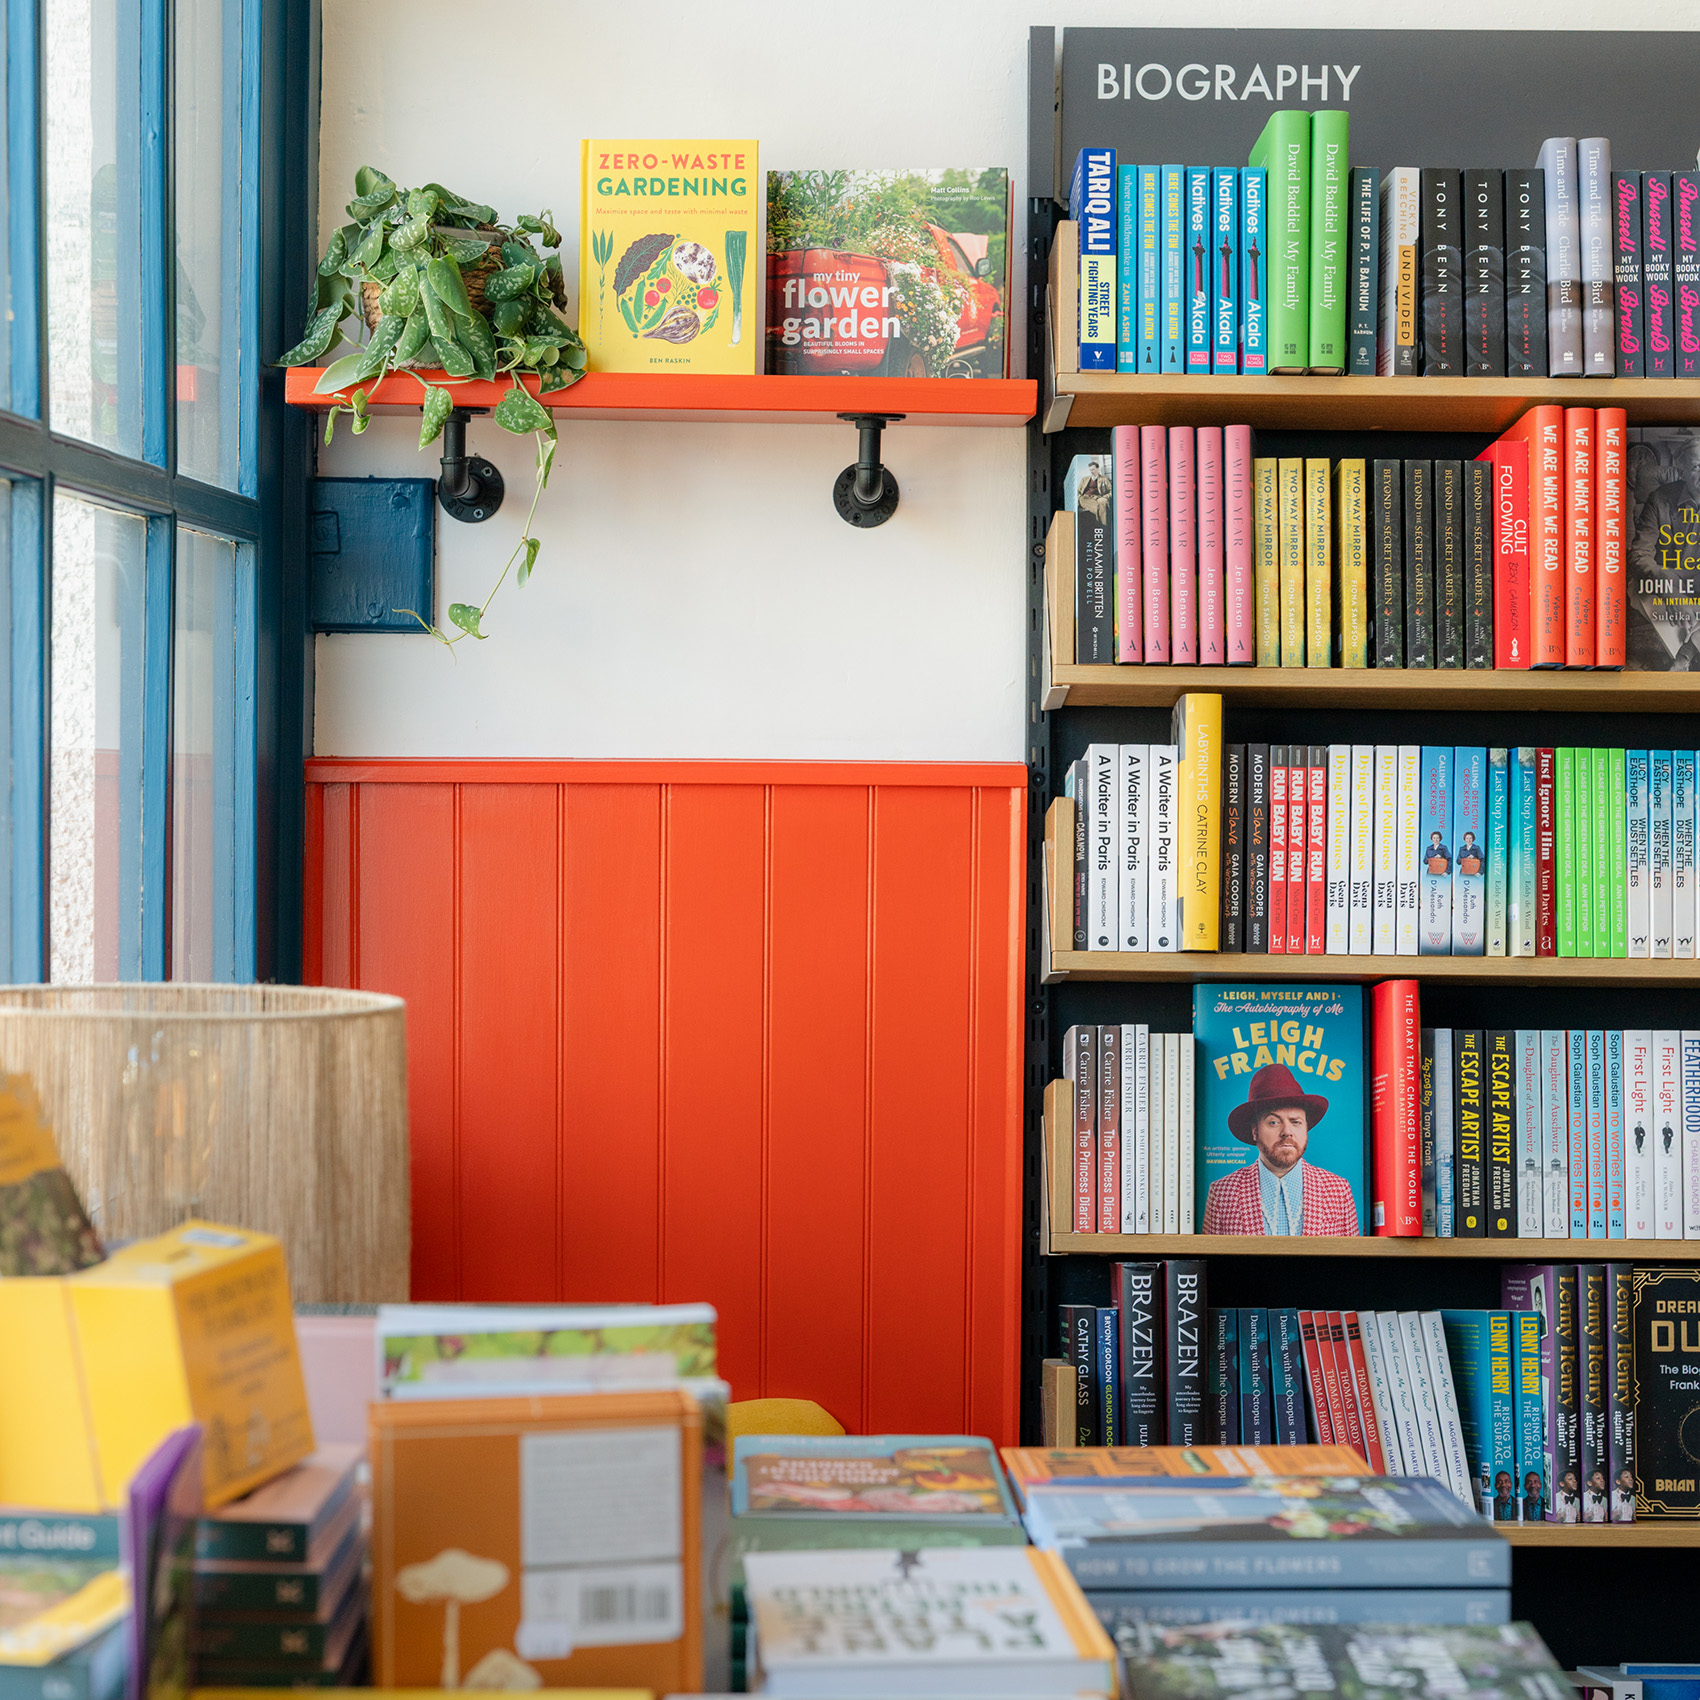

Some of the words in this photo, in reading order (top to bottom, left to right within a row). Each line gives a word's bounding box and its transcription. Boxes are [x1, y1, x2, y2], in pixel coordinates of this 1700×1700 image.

[1097, 63, 1361, 101] BIOGRAPHY
[599, 153, 745, 170] ZERO-WASTE
[1286, 144, 1300, 183] David
[1556, 147, 1567, 177] Time
[597, 177, 747, 197] GARDENING
[1084, 151, 1111, 214] TARIQ
[1363, 177, 1372, 193] THE
[1557, 178, 1569, 199] and
[629, 209, 648, 217] space
[1218, 174, 1233, 232] Natives
[1286, 185, 1300, 233] Baddiel
[1362, 196, 1371, 220] LIFE
[1409, 191, 1417, 228] VICKY
[1436, 181, 1446, 231] TONY
[1558, 201, 1569, 228] Tide
[1618, 178, 1638, 253] Russell
[1088, 217, 1111, 250] ALI
[1361, 224, 1370, 240] OF
[1361, 243, 1370, 252] P.
[1283, 240, 1299, 262] My
[1360, 254, 1369, 265] T.
[1559, 236, 1570, 277] Charlie
[1621, 256, 1633, 264] MY
[813, 272, 833, 284] my
[835, 269, 861, 284] tiny
[1088, 260, 1099, 305] FIGHTING
[1437, 245, 1447, 293] BENN
[1615, 265, 1640, 274] BOOKY
[1615, 273, 1639, 283] WOOK
[782, 278, 900, 309] flower
[1099, 282, 1110, 318] STREET
[1282, 265, 1299, 311] Family
[1359, 267, 1369, 312] BARNUM
[1402, 250, 1411, 340] UNDIVIDED
[1560, 279, 1573, 304] Bird
[782, 308, 901, 346] garden
[1088, 306, 1099, 338] YEARS
[1218, 299, 1233, 346] Akala
[1619, 285, 1640, 354] Brand
[1543, 424, 1557, 446] WE
[1543, 447, 1557, 472] ARE
[1233, 458, 1243, 500] WILD
[1263, 468, 1272, 522] TWO-WAY
[1383, 468, 1392, 509] BEYOND
[1543, 476, 1558, 512] WHAT
[1233, 506, 1244, 549] YEAR
[1499, 465, 1513, 555] FOLLOWING
[1543, 515, 1558, 536] WE
[1264, 524, 1273, 567] MIRROR
[1383, 525, 1392, 566] SECRET
[1514, 519, 1527, 555] CULT
[1658, 524, 1700, 546] Sec
[1094, 528, 1104, 578] BENJAMIN
[1543, 538, 1558, 572] READ
[1235, 565, 1244, 584] Jen
[1384, 566, 1393, 606] GARDEN
[1638, 579, 1673, 594] JOHN
[1678, 579, 1695, 594] LE
[1094, 581, 1104, 619] BRITTEN
[1235, 588, 1243, 628] Benson
[1651, 611, 1691, 621] Suleika
[1128, 755, 1141, 767] A
[1197, 723, 1209, 801] LABYRINTHS
[1540, 752, 1552, 780] Just
[1638, 758, 1646, 782] LUCY
[1127, 767, 1141, 819] Waiter
[1229, 754, 1238, 804] MODERN
[1272, 769, 1286, 800] RUN
[1494, 771, 1505, 792] Last
[1629, 757, 1638, 808] EASTHOPE
[1492, 793, 1505, 819] Stop
[1538, 783, 1552, 828] Ignore
[1128, 822, 1140, 833] in
[1196, 804, 1209, 858] CATRINE
[1228, 807, 1237, 846] Slave
[1272, 804, 1285, 847] BABY
[1630, 820, 1638, 840] DUST
[1639, 817, 1647, 846] WHEN
[1127, 836, 1140, 871] Paris
[1494, 821, 1505, 876] Auschwitz
[1541, 831, 1552, 860] Him
[1639, 849, 1647, 866] THE
[1196, 861, 1208, 895] CLAY
[1272, 850, 1285, 882] RUN
[1630, 844, 1639, 888] SETTLES
[1329, 881, 1338, 908] Davis
[1337, 880, 1346, 909] Geena
[1213, 1002, 1234, 1013] The
[1235, 1002, 1311, 1018] Autobiography
[1312, 1004, 1324, 1016] of
[1325, 1003, 1344, 1016] Me
[1223, 991, 1259, 1001] LEIGH,
[1261, 991, 1304, 1001] MYSELF
[1305, 992, 1329, 1001] AND
[1332, 992, 1336, 1001] I
[1405, 994, 1414, 1013] THE
[1232, 1020, 1324, 1050] LEIGH
[1405, 1018, 1414, 1051] DIARY
[1464, 1034, 1475, 1049] THE
[1079, 1051, 1091, 1086] Carrie
[1213, 1044, 1346, 1081] FRANCIS
[1406, 1055, 1415, 1081] THAT
[1461, 1051, 1480, 1107] ESCAPE
[1634, 1047, 1647, 1076] First
[1631, 1081, 1647, 1113] Light
[1684, 1039, 1700, 1133] FEATHERHOOD
[1080, 1088, 1091, 1122] Fisher
[1406, 1086, 1416, 1140] CHANGED
[1079, 1129, 1091, 1148] The
[1461, 1109, 1480, 1162] ARTIST
[1408, 1145, 1416, 1164] THE
[1079, 1151, 1091, 1194] Princess
[1408, 1169, 1417, 1208] WORLD
[1462, 1164, 1470, 1208] FREEDLAND
[1472, 1165, 1480, 1206] JONATHAN
[1079, 1196, 1091, 1230] Diarist
[1176, 1274, 1199, 1378] BRAZEN
[1556, 1275, 1575, 1342] Lenny
[1077, 1318, 1089, 1362] CATHY
[1131, 1275, 1153, 1379] BRAZEN
[1250, 1315, 1259, 1350] Dancing
[1490, 1316, 1508, 1354] LENNY
[1252, 1352, 1260, 1372] with
[1491, 1357, 1510, 1396] HENRY
[1557, 1345, 1575, 1410] Henry
[1078, 1364, 1089, 1406] GLASS
[1252, 1373, 1260, 1388] the
[1252, 1389, 1261, 1426] Octopus
[1357, 1367, 1370, 1408] THOMAS
[1364, 1410, 1377, 1444] HARDY
[1655, 1478, 1696, 1492] BRIAN
[1075, 1558, 1119, 1576] HOW
[1125, 1558, 1149, 1576] TO
[1152, 1557, 1207, 1576] GROW
[1213, 1556, 1249, 1575] THE
[1253, 1556, 1342, 1574] FLOWERS
